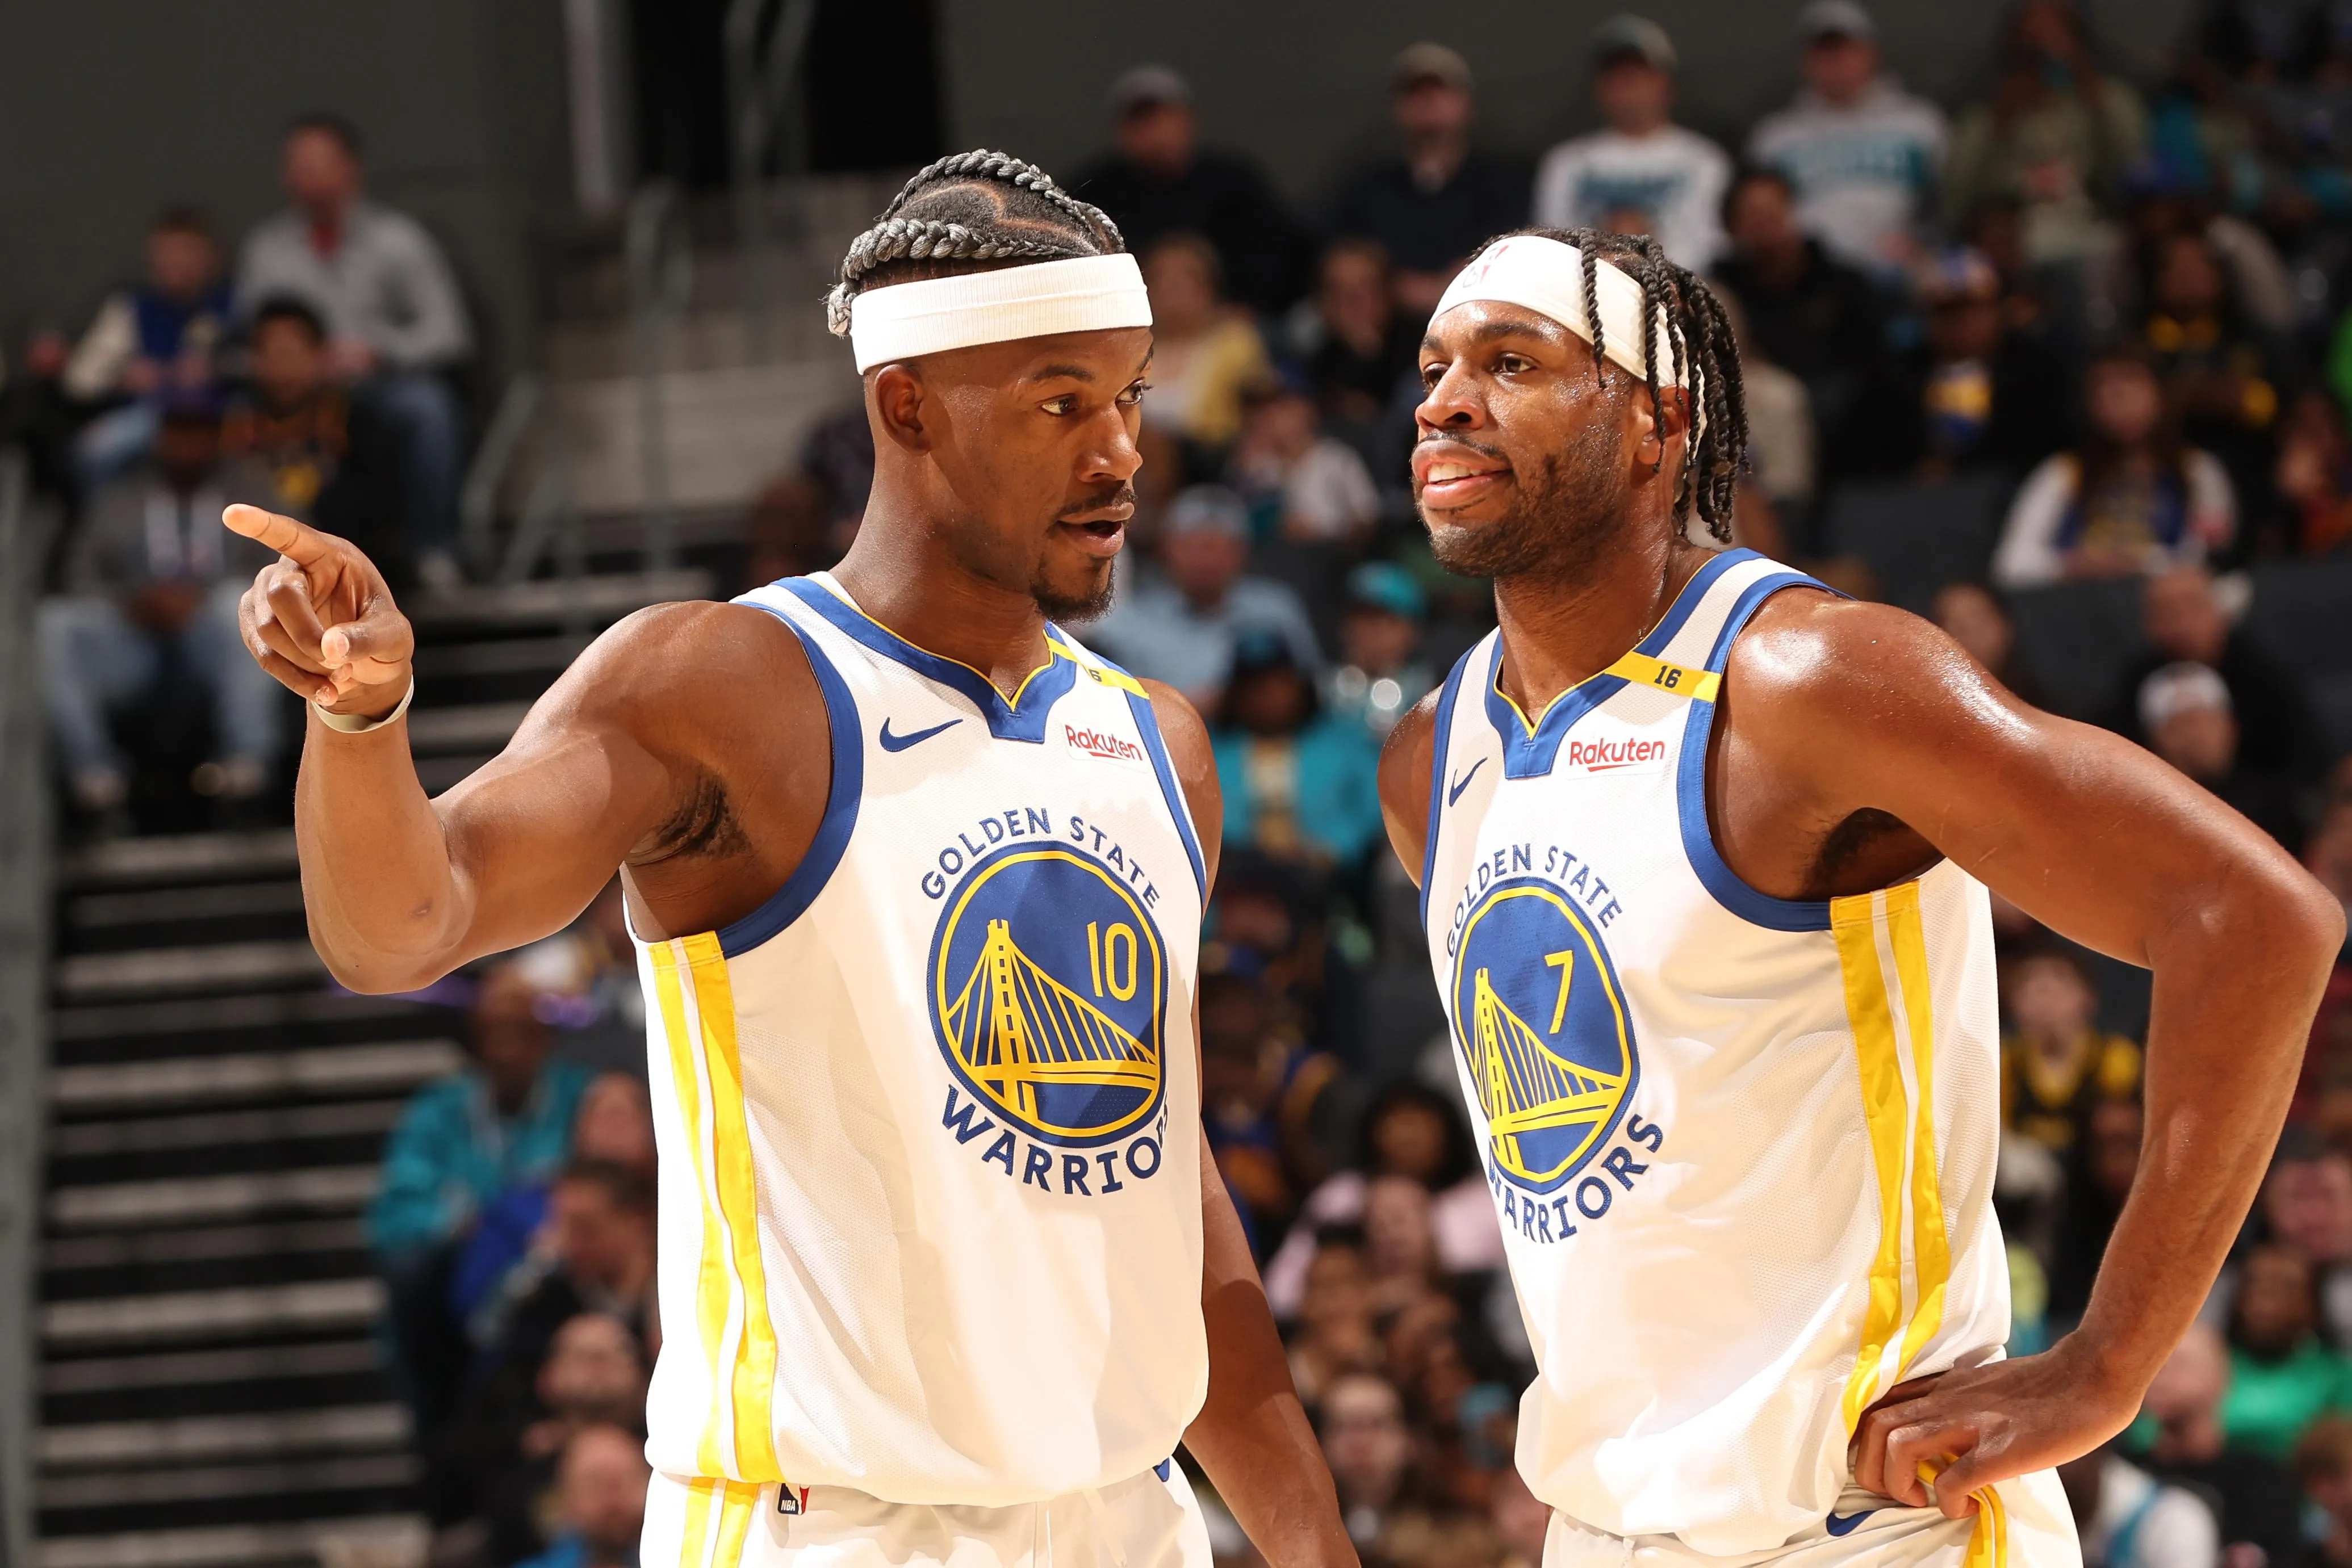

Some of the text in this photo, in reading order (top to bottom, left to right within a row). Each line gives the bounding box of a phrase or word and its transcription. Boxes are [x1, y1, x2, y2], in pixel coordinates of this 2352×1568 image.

[1654, 665, 1682, 688] 16
[1065, 724, 1143, 761] Rakuten
[1569, 737, 1665, 766] Rakuten
[921, 807, 1160, 909] GOLDEN STATE
[1447, 842, 1622, 958] GOLDEN STATE
[1087, 921, 1137, 1001] 10
[1545, 949, 1573, 1034] 7
[941, 1083, 1168, 1196] WARRIO
[781, 1499, 796, 1511] NBA
